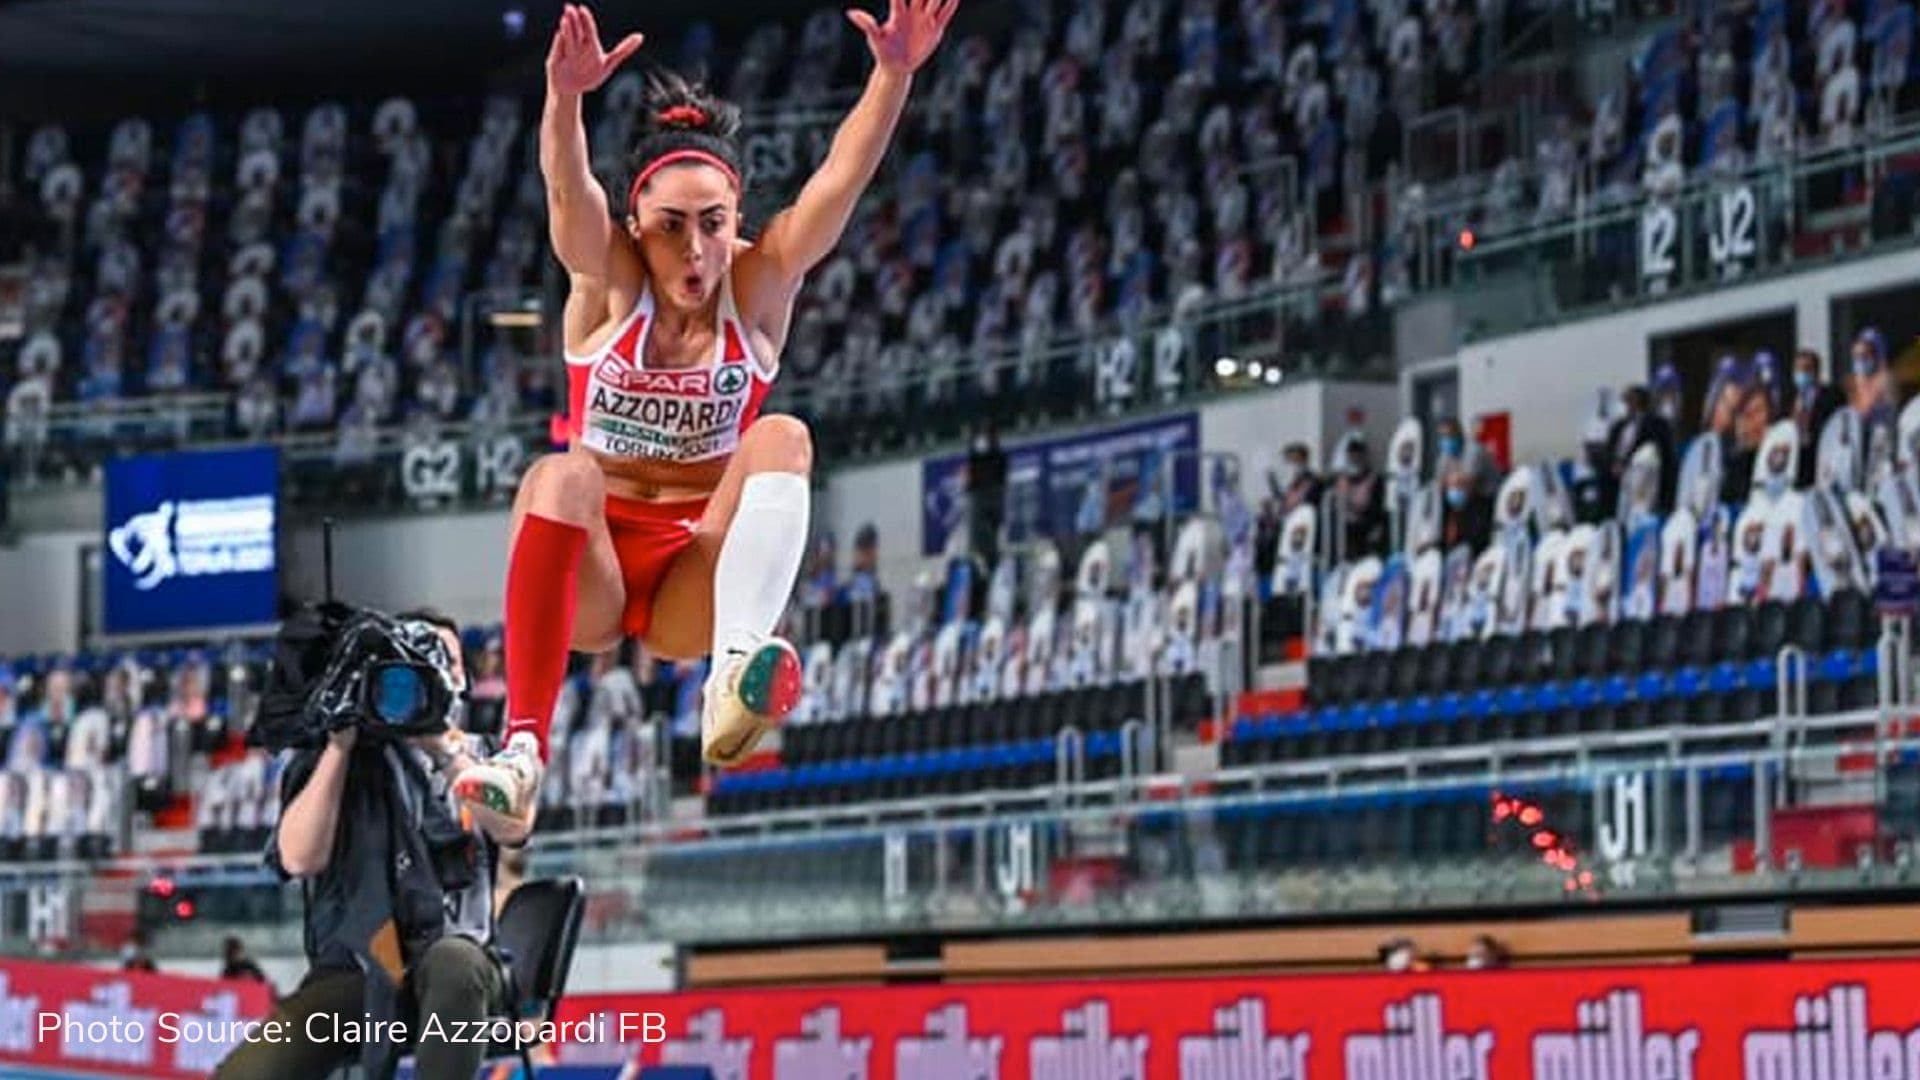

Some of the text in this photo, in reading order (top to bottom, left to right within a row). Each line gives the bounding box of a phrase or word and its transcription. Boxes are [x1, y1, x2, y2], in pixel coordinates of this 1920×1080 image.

[1710, 187, 1755, 263] J2
[599, 357, 708, 394] SPAR
[402, 440, 460, 495] G2
[477, 438, 523, 491] H2
